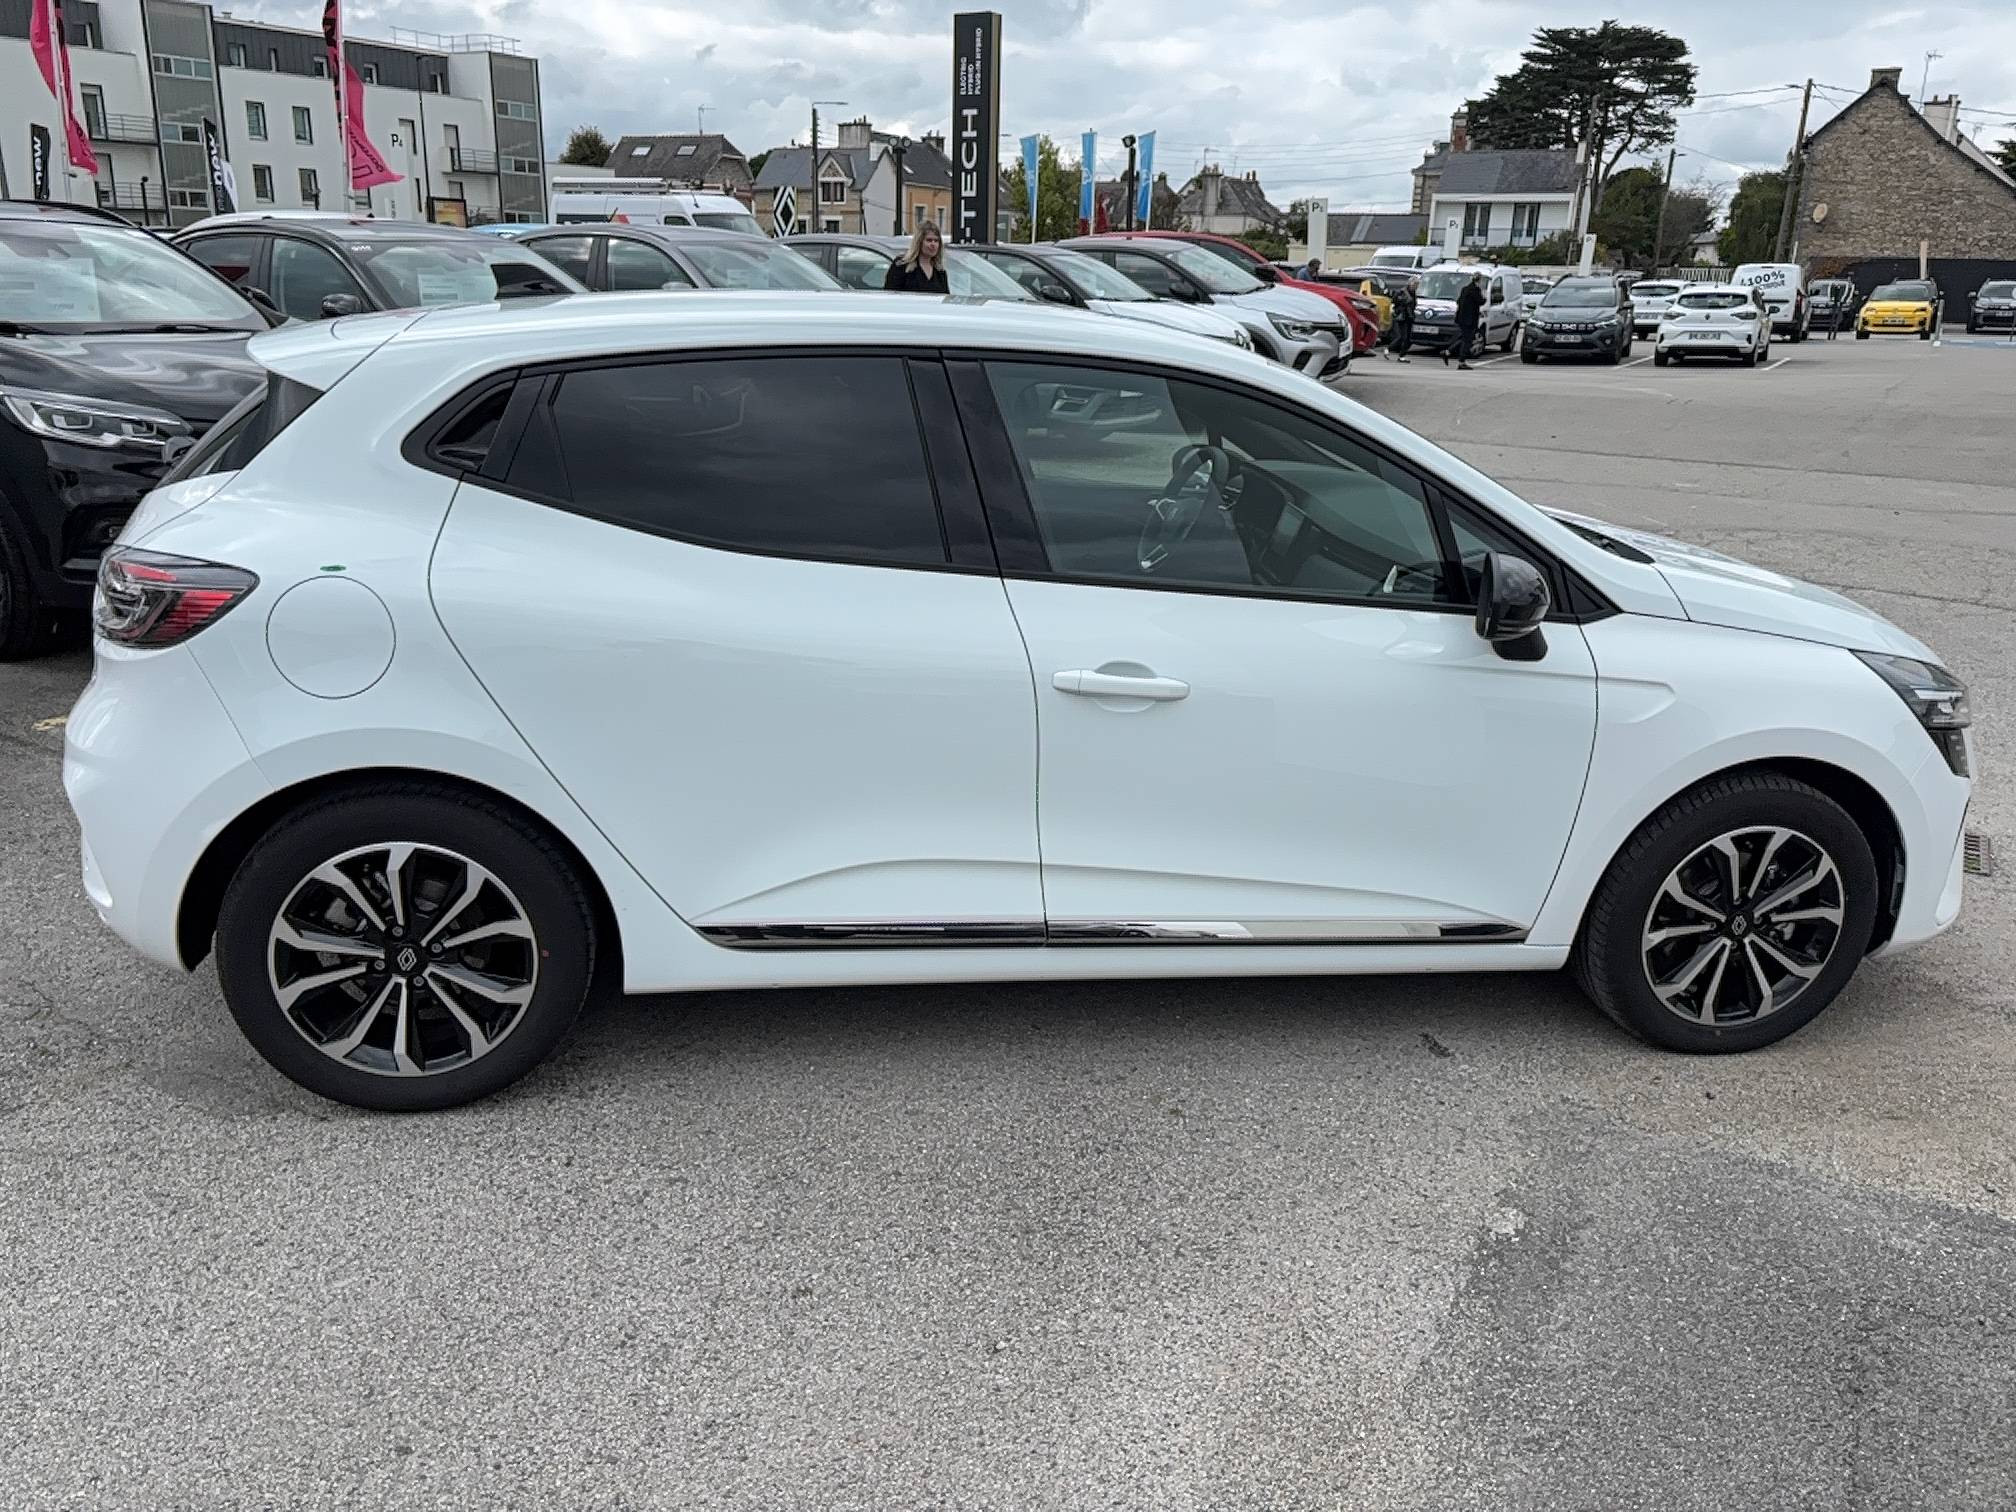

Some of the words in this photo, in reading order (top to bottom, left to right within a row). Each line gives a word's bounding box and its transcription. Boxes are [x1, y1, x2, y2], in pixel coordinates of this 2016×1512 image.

[967, 63, 975, 95] HYBRID
[33, 135, 42, 186] new
[960, 108, 979, 245] -TECH
